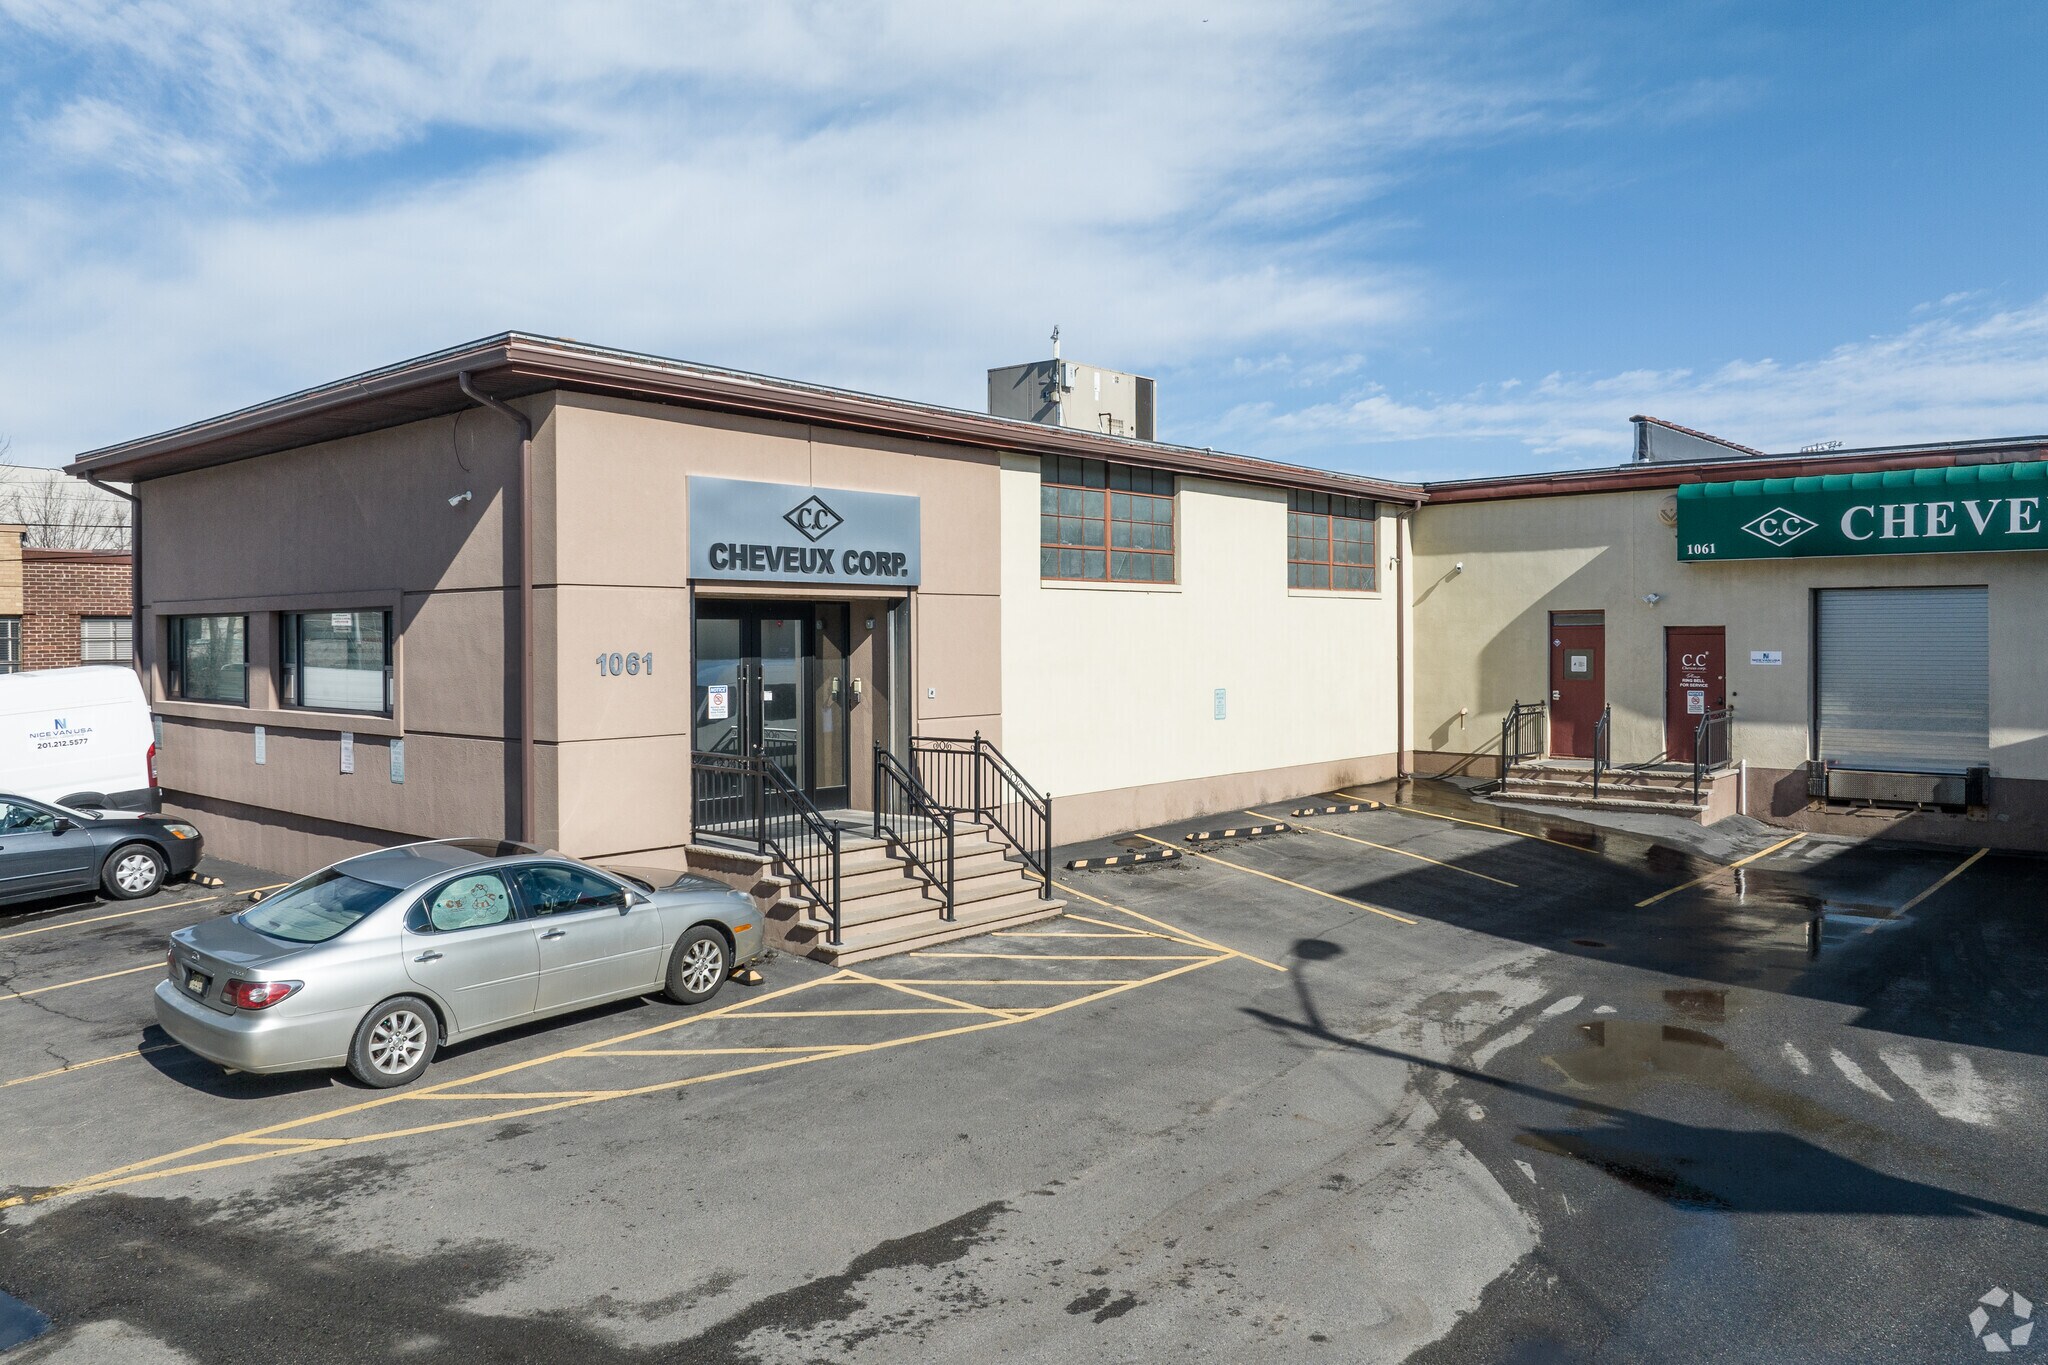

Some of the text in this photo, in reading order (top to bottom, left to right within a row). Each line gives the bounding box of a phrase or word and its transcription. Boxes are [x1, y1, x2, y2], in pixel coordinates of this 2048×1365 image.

[1840, 496, 2048, 541] CHEVE
[709, 542, 908, 577] CHEVEUX CORP.
[1687, 543, 1716, 555] 1061
[595, 652, 653, 677] 1061
[37, 738, 88, 750] 201.212.5577
